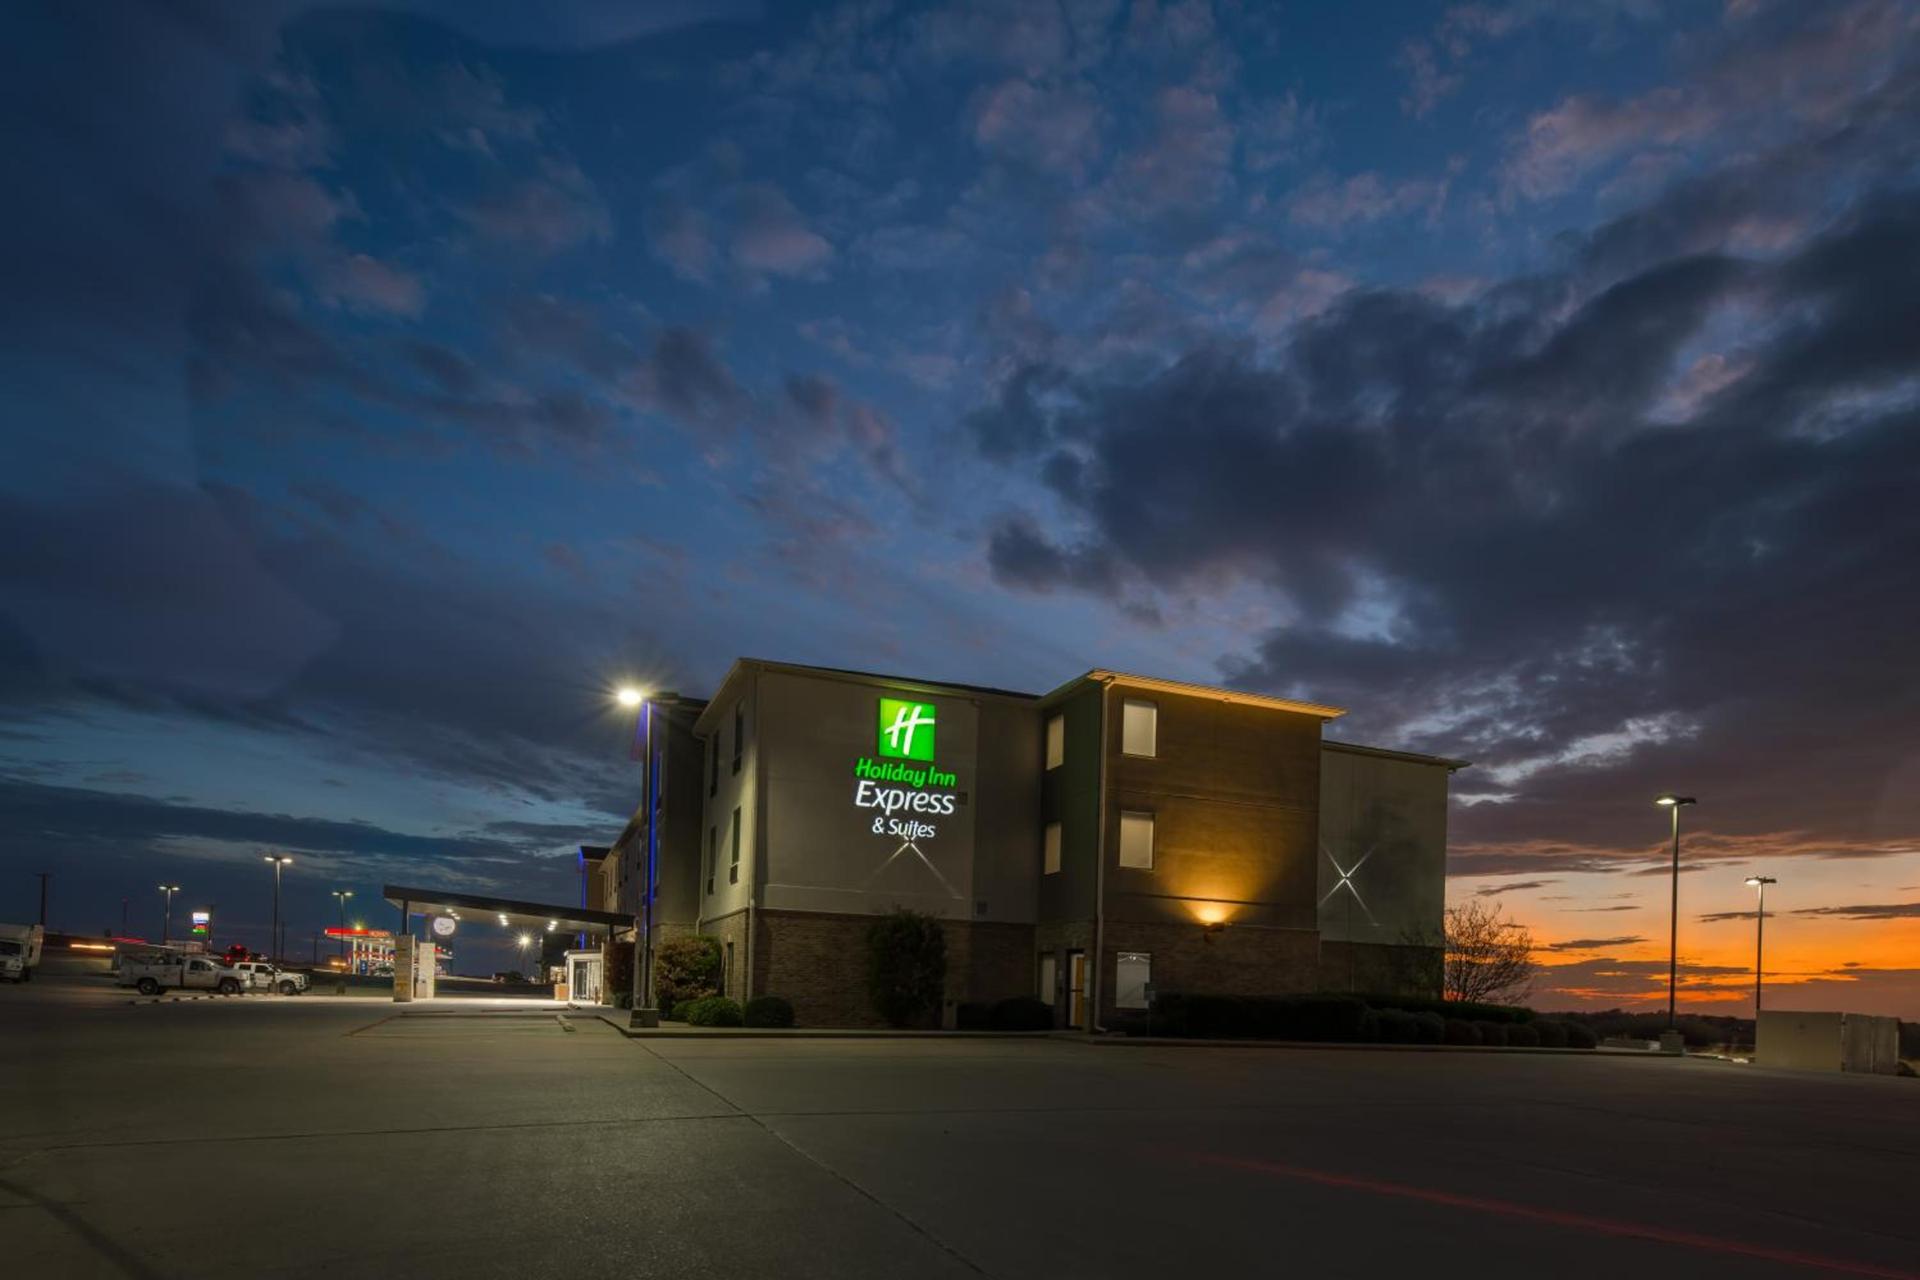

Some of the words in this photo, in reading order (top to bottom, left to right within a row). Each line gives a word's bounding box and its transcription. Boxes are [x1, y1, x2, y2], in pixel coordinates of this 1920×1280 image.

[884, 706, 934, 755] H
[856, 758, 926, 787] Holiday
[929, 767, 956, 786] Inn
[855, 780, 955, 816] Express
[872, 817, 885, 834] &
[888, 819, 936, 838] Suites
